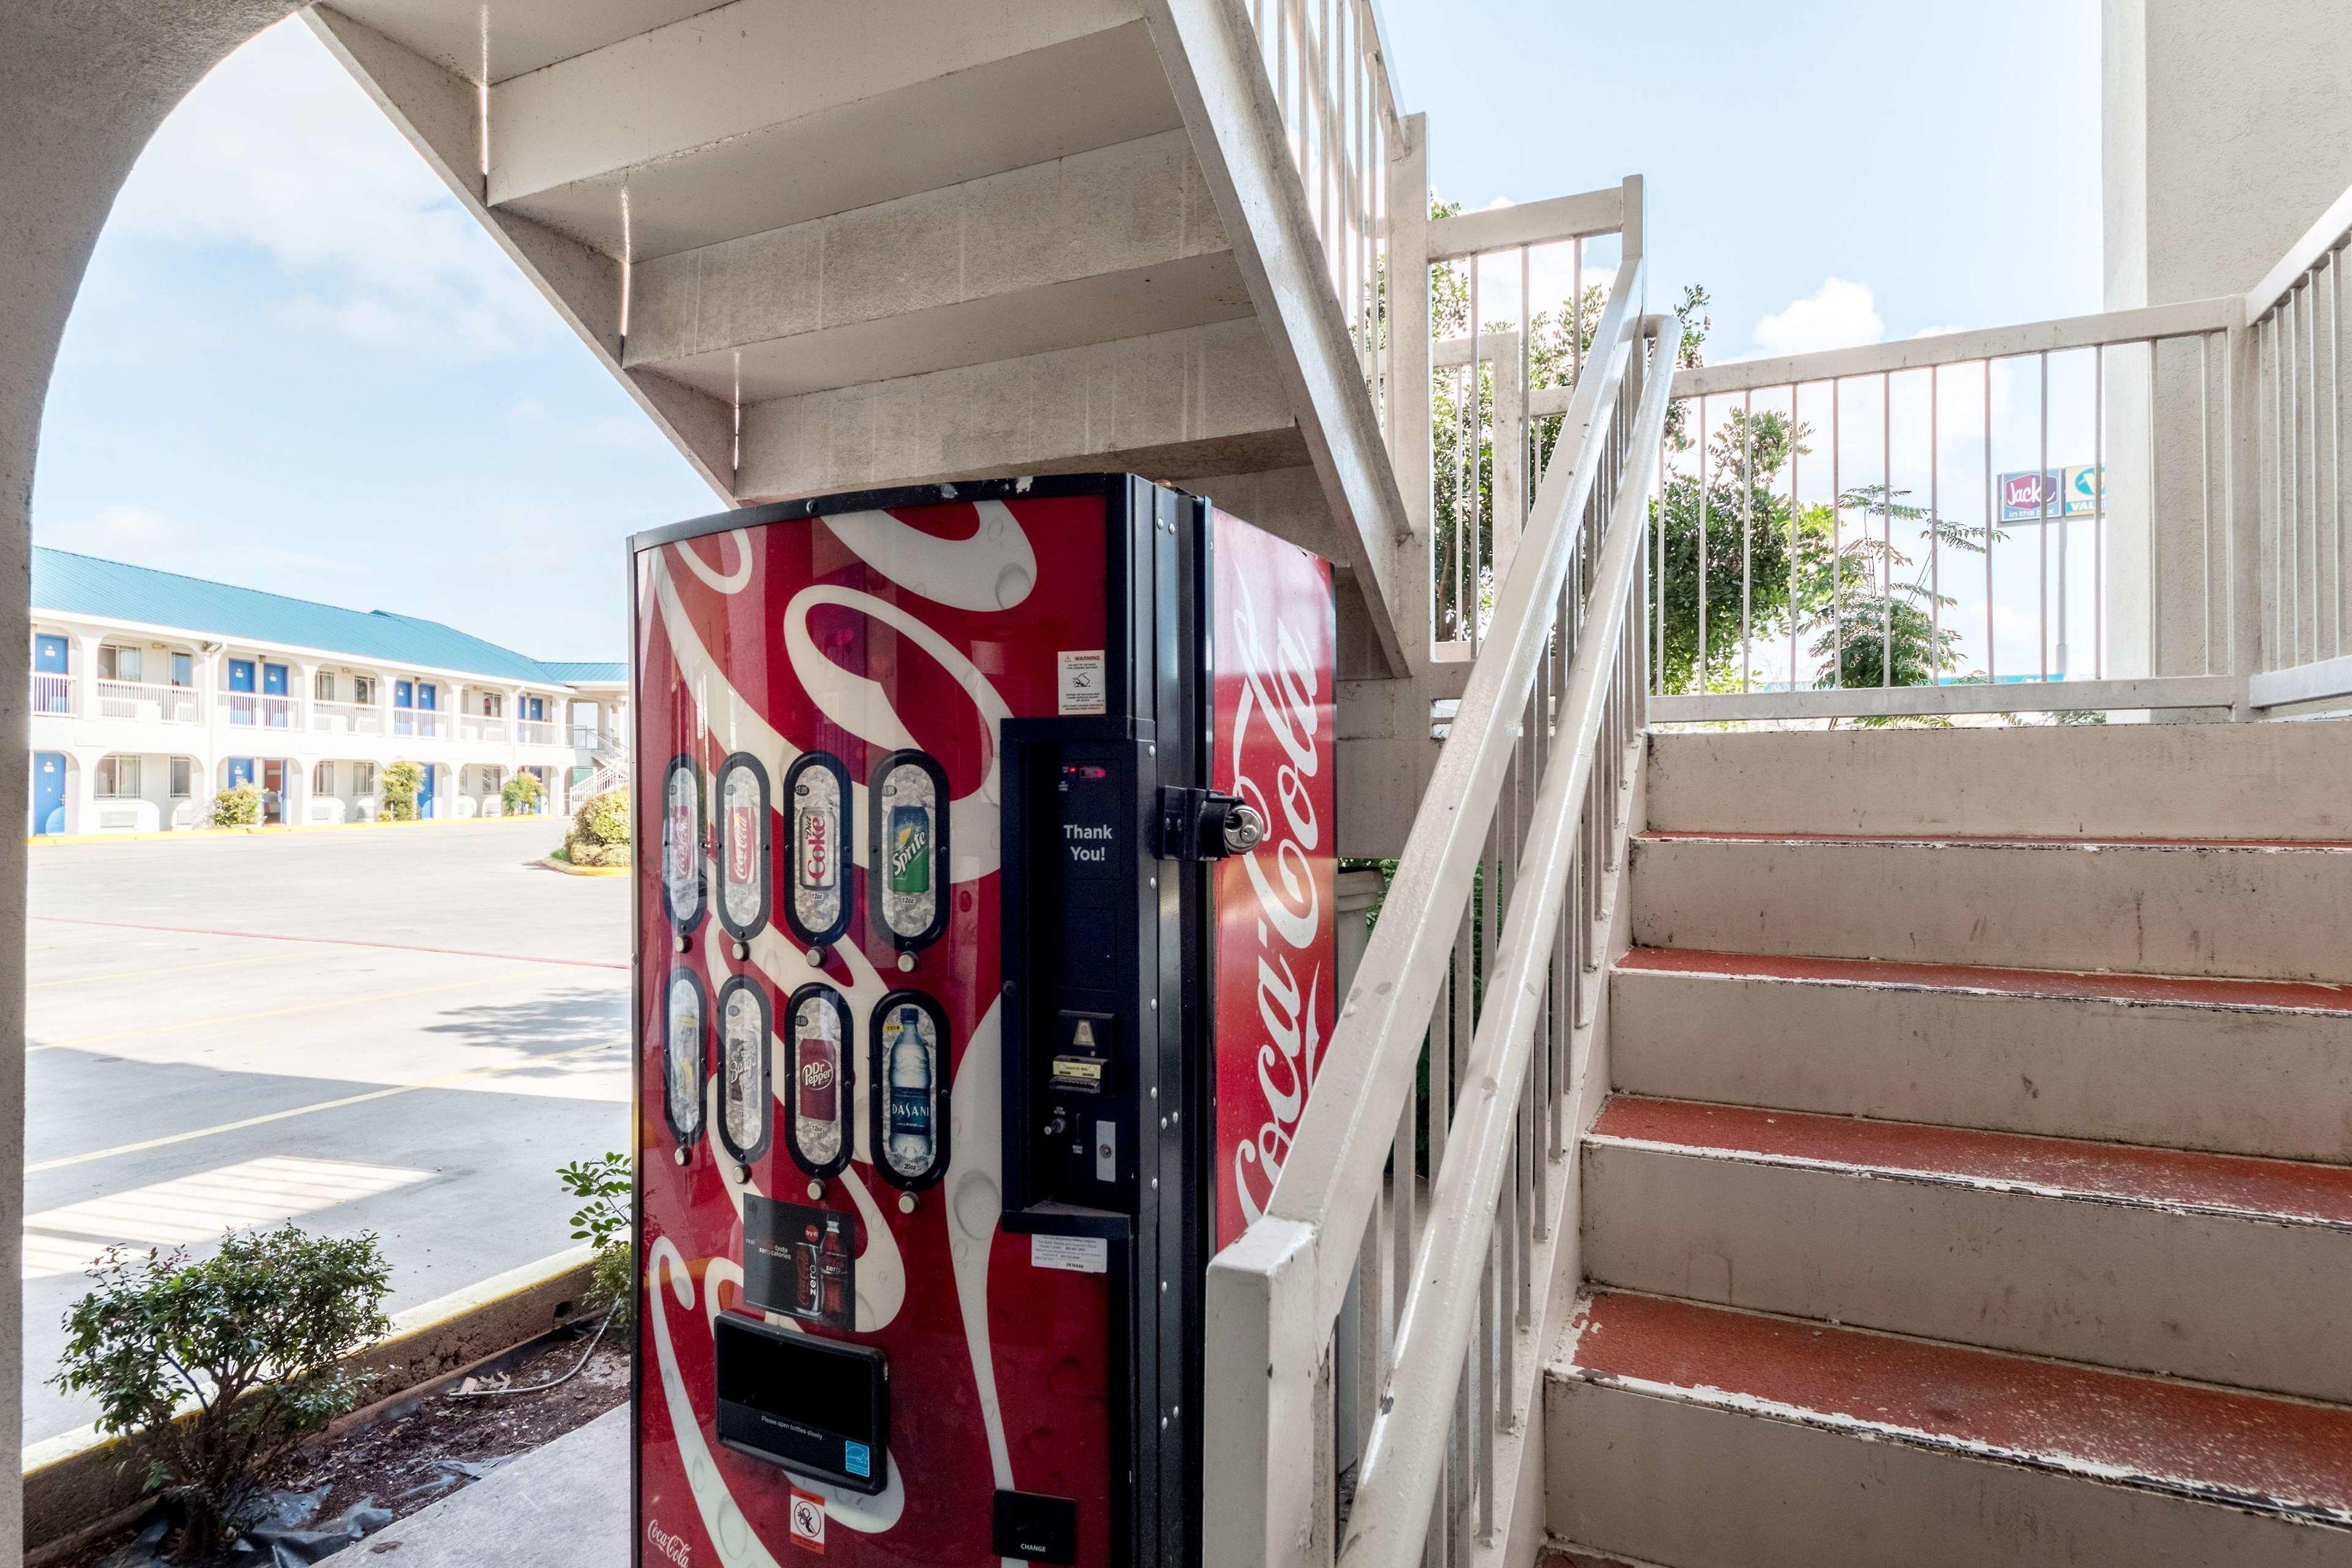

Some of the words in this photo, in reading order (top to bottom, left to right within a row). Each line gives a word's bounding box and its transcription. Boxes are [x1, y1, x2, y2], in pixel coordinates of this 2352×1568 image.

[2007, 478, 2055, 505] Jack
[1063, 824, 1113, 839] Thank
[808, 817, 826, 879] Coke
[892, 830, 926, 876] Sprite
[1070, 846, 1105, 861] You!
[804, 1064, 833, 1087] Pepper
[812, 1062, 825, 1074] Dr
[892, 1103, 929, 1118] DASANI
[771, 1251, 791, 1259] calories
[825, 1265, 841, 1273] zero
[761, 1416, 777, 1425] Please
[790, 1424, 807, 1435] bottles
[807, 1429, 822, 1440] slowly
[648, 1519, 692, 1568] Coca-Cola
[1021, 1543, 1046, 1552] CHANGE
